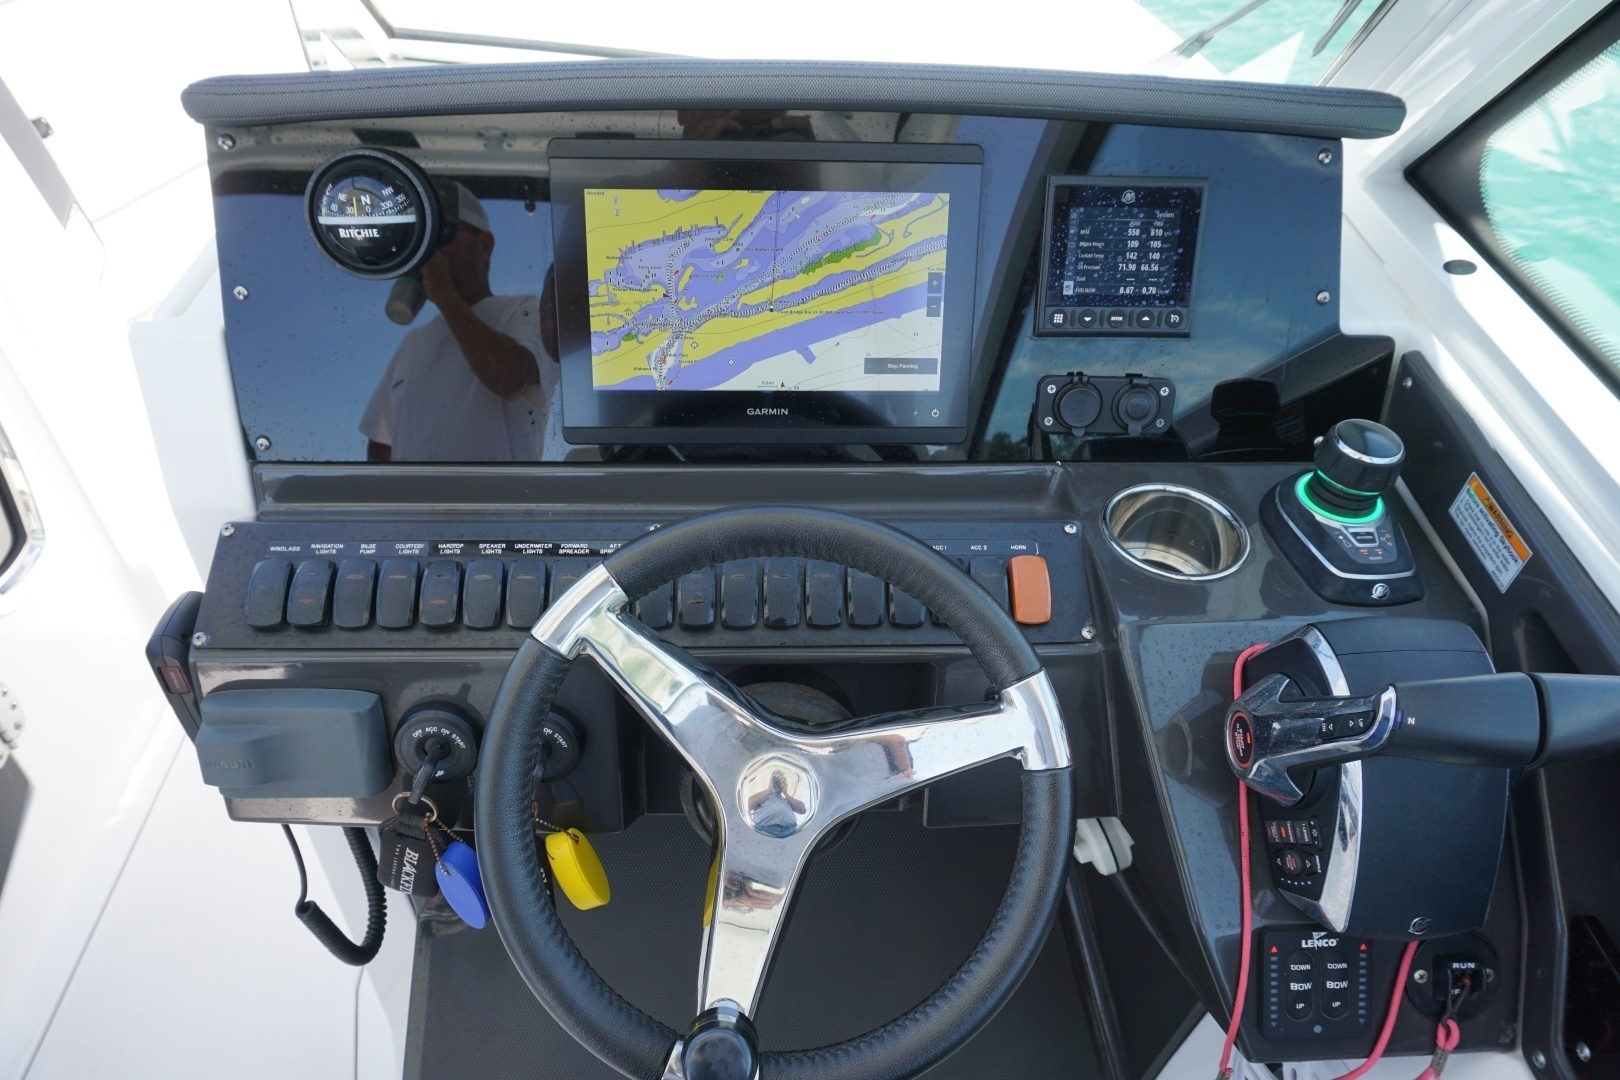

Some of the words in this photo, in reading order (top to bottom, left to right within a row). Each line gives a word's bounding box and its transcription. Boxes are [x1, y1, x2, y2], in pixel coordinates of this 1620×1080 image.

[381, 186, 394, 196] NW
[338, 193, 347, 202] NE
[361, 195, 371, 205] N
[396, 193, 407, 203] 300
[331, 203, 338, 212] 60
[346, 206, 354, 214] 30
[380, 200, 394, 211] 330
[338, 228, 380, 238] RITCHIE
[747, 408, 789, 416] GARMIN
[1488, 502, 1513, 539] WARNING
[1466, 487, 1479, 508] Before
[1480, 507, 1499, 537] activating
[1500, 535, 1519, 566] Skyhook:
[1408, 717, 1415, 725] N
[413, 729, 422, 737] OFF
[452, 734, 466, 749] START
[554, 733, 568, 748] START
[1301, 939, 1337, 948] LENCO
[1290, 982, 1312, 990] BOW
[1326, 981, 1348, 989] BOW
